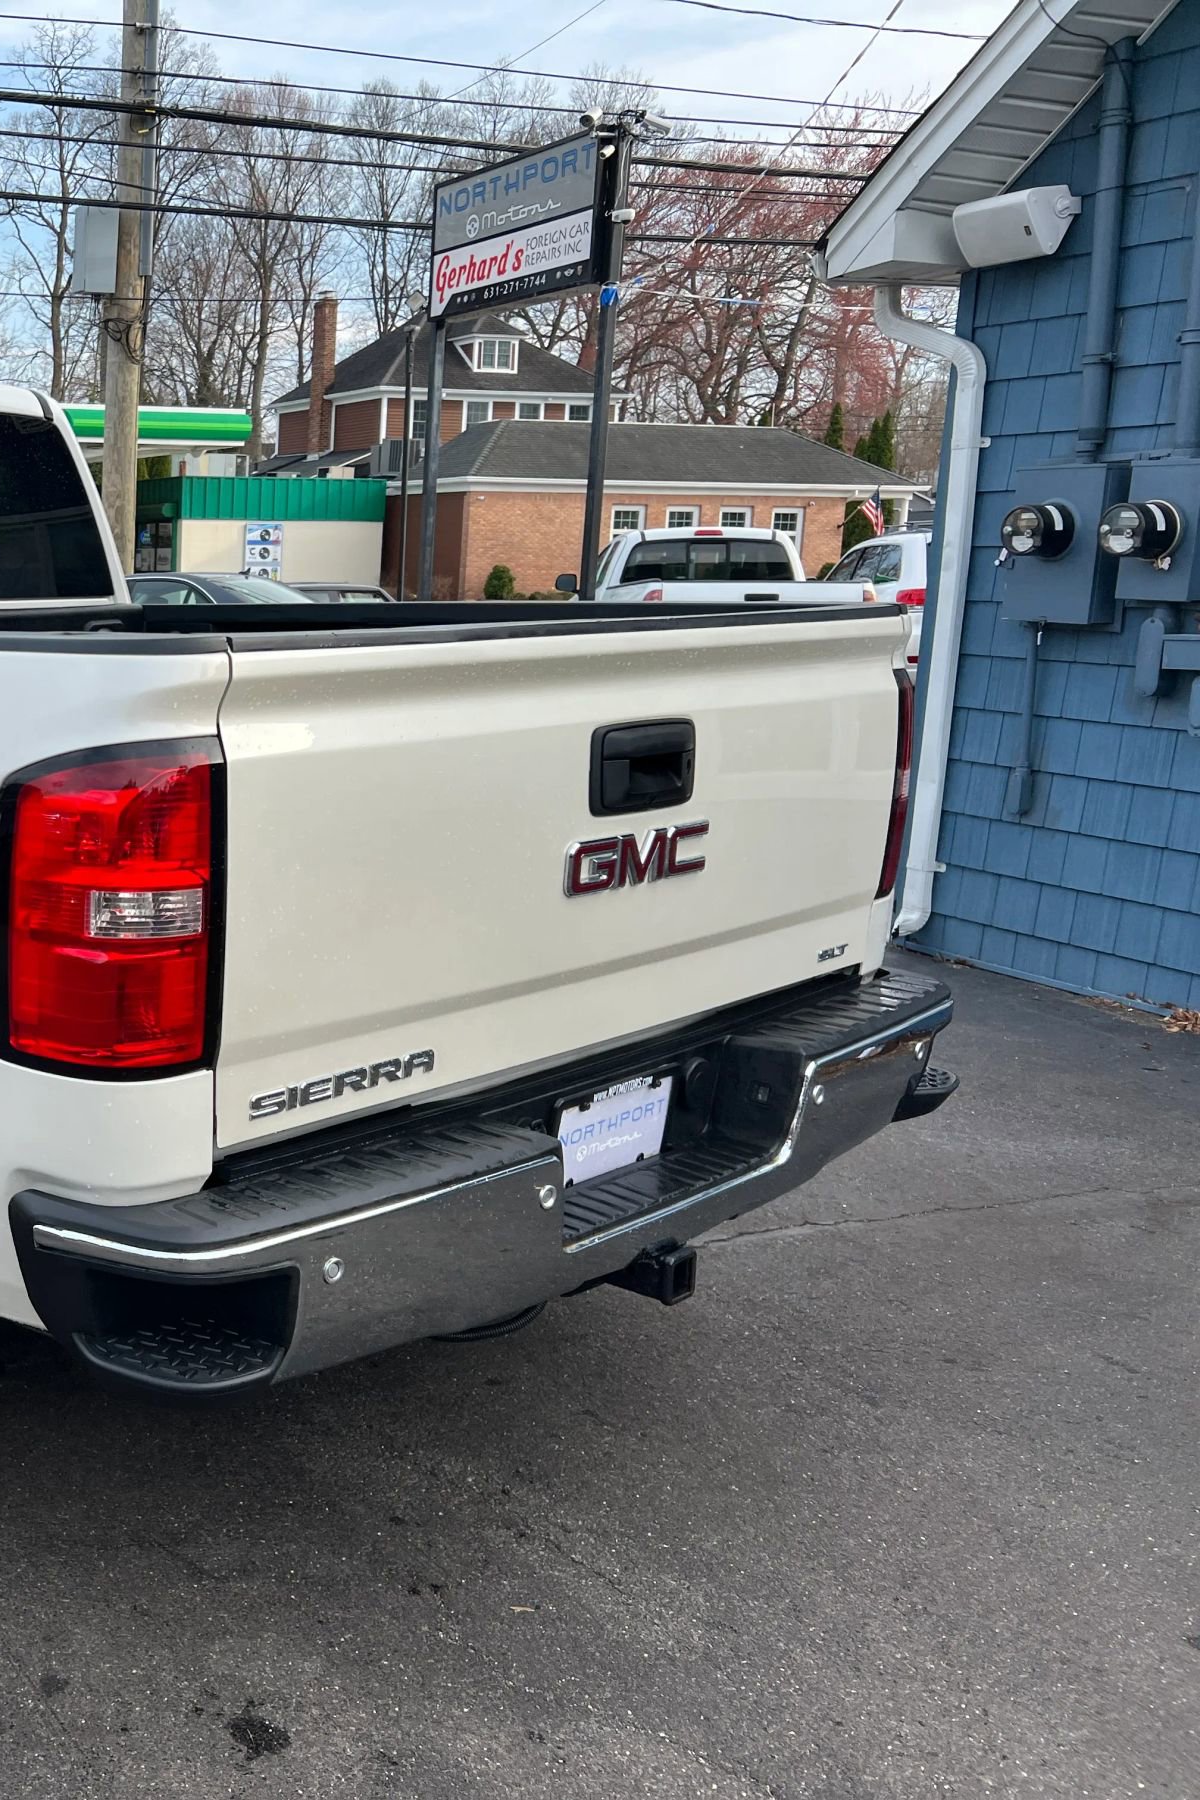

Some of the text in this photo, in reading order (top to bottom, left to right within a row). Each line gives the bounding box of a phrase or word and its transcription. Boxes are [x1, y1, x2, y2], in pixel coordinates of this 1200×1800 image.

[439, 141, 597, 218] NORTHPORT
[524, 239, 583, 268] REPAIRS INC
[526, 221, 590, 252] FOREIGN CAR
[436, 239, 524, 304] Gerhard's
[483, 273, 547, 299] 631-271-7744
[563, 819, 710, 898] GMC
[817, 943, 849, 963] SLT
[249, 1048, 436, 1121] SIERRA
[560, 1098, 665, 1147] NORTHPORT
